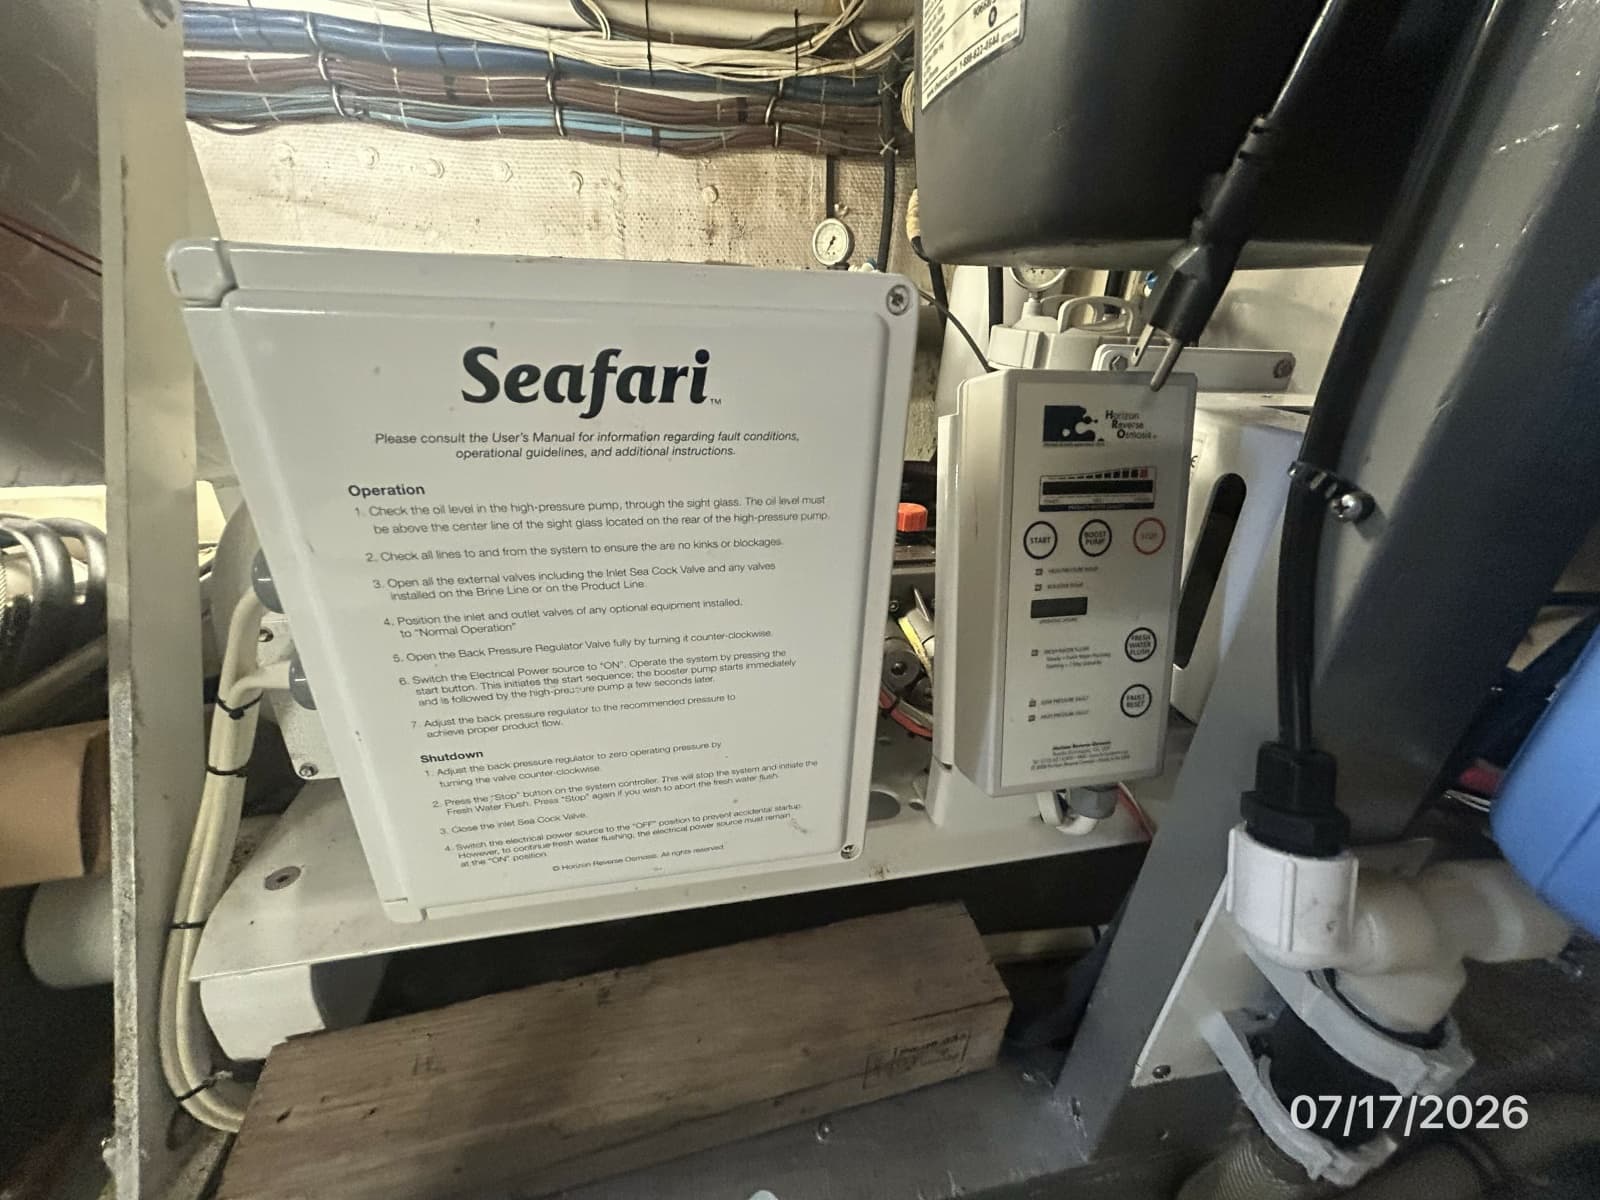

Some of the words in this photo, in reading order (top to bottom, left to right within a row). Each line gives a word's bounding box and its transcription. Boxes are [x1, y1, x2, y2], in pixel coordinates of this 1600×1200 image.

[461, 346, 710, 420] Seafari
[375, 432, 416, 443] Please
[420, 432, 465, 443] consult
[469, 432, 488, 442] the
[492, 432, 529, 442] User's
[532, 432, 575, 442] Manual
[578, 431, 594, 441] for
[597, 432, 660, 441] information
[663, 431, 715, 444] regarding
[718, 431, 740, 441] fault
[743, 431, 799, 442] conditions,
[456, 447, 522, 460] operational
[526, 447, 586, 459] guidelines,
[591, 446, 612, 456] and
[615, 446, 669, 456] additional
[672, 446, 735, 455] instructions.
[348, 484, 425, 498] Operation
[369, 506, 408, 516] Check
[410, 505, 429, 514] the
[432, 504, 445, 514] oil
[448, 504, 473, 513] level
[476, 504, 486, 513] in
[489, 503, 507, 512] the
[510, 502, 585, 514] high-pressure
[588, 502, 622, 512] pump,
[625, 499, 665, 511] through
[668, 499, 684, 508] the
[686, 497, 710, 510] sight
[713, 498, 741, 509] glass.
[746, 496, 763, 506] The
[765, 496, 776, 505] oil
[779, 496, 799, 505] level
[802, 495, 825, 504] must
[373, 525, 389, 534] be
[392, 523, 428, 533] above
[430, 523, 449, 531] the
[452, 522, 487, 531] center
[490, 520, 510, 530] line
[512, 519, 523, 529] of
[526, 520, 543, 529] the
[546, 519, 573, 531] sight
[575, 517, 603, 530] glass
[605, 516, 643, 526] located
[646, 517, 659, 525] on
[662, 516, 678, 525] the
[681, 516, 701, 524] rear
[702, 513, 713, 524] of
[715, 514, 731, 523] the
[733, 512, 798, 525] high-pressure
[1030, 536, 1051, 545] START
[1085, 538, 1105, 546] PUMP
[380, 551, 418, 561] Check
[421, 550, 433, 559] all
[436, 550, 461, 558] lines
[464, 549, 475, 557] to
[478, 548, 500, 556] and
[502, 547, 527, 555] from
[529, 546, 547, 555] the
[550, 546, 588, 556] system
[590, 544, 602, 552] to
[603, 544, 638, 552] ensure
[640, 542, 657, 551] the
[693, 540, 719, 549] kinks
[720, 540, 731, 548] or
[387, 578, 419, 589] Open
[422, 576, 433, 586] all
[436, 576, 454, 585] the
[457, 573, 500, 584] external
[502, 573, 536, 581] valves
[538, 570, 584, 582] including
[586, 569, 603, 577] the
[606, 568, 627, 576] Inlet
[629, 567, 649, 576] Sea
[651, 566, 678, 574] Cock
[679, 565, 705, 573] Valve
[708, 563, 726, 572] and
[728, 564, 745, 574] any
[747, 562, 775, 571] valves
[391, 589, 436, 599] installed
[438, 590, 453, 599] on
[455, 588, 473, 596] the
[476, 587, 504, 596] Brine
[507, 585, 529, 594] Line
[545, 584, 559, 592] on
[561, 583, 579, 591] the
[580, 581, 620, 590] Product
[623, 579, 644, 588] Line.
[397, 616, 441, 625] Position
[443, 614, 461, 622] the
[464, 612, 485, 621] inlet
[488, 611, 508, 620] and
[511, 610, 540, 618] outlet
[542, 607, 574, 618] valves
[576, 606, 588, 616] of
[589, 606, 607, 615] any
[609, 602, 648, 615] optional
[651, 600, 700, 612] equipment
[703, 597, 742, 607] installed.
[399, 630, 412, 638] to
[406, 652, 436, 662] Open
[438, 650, 456, 659] the
[458, 649, 486, 658] Back
[488, 645, 533, 657] Pressure
[535, 642, 583, 653] Regulator
[584, 640, 610, 648] Valve
[613, 638, 631, 648] fully
[634, 638, 646, 647] by
[648, 635, 680, 645] turning
[682, 633, 688, 642] it
[427, 728, 464, 737] achieve
[466, 725, 499, 736] proper
[501, 720, 538, 733] product
[542, 718, 564, 728] flow.
[420, 750, 484, 764] Shutdown
[439, 778, 473, 787] turning
[492, 774, 516, 782] valve
